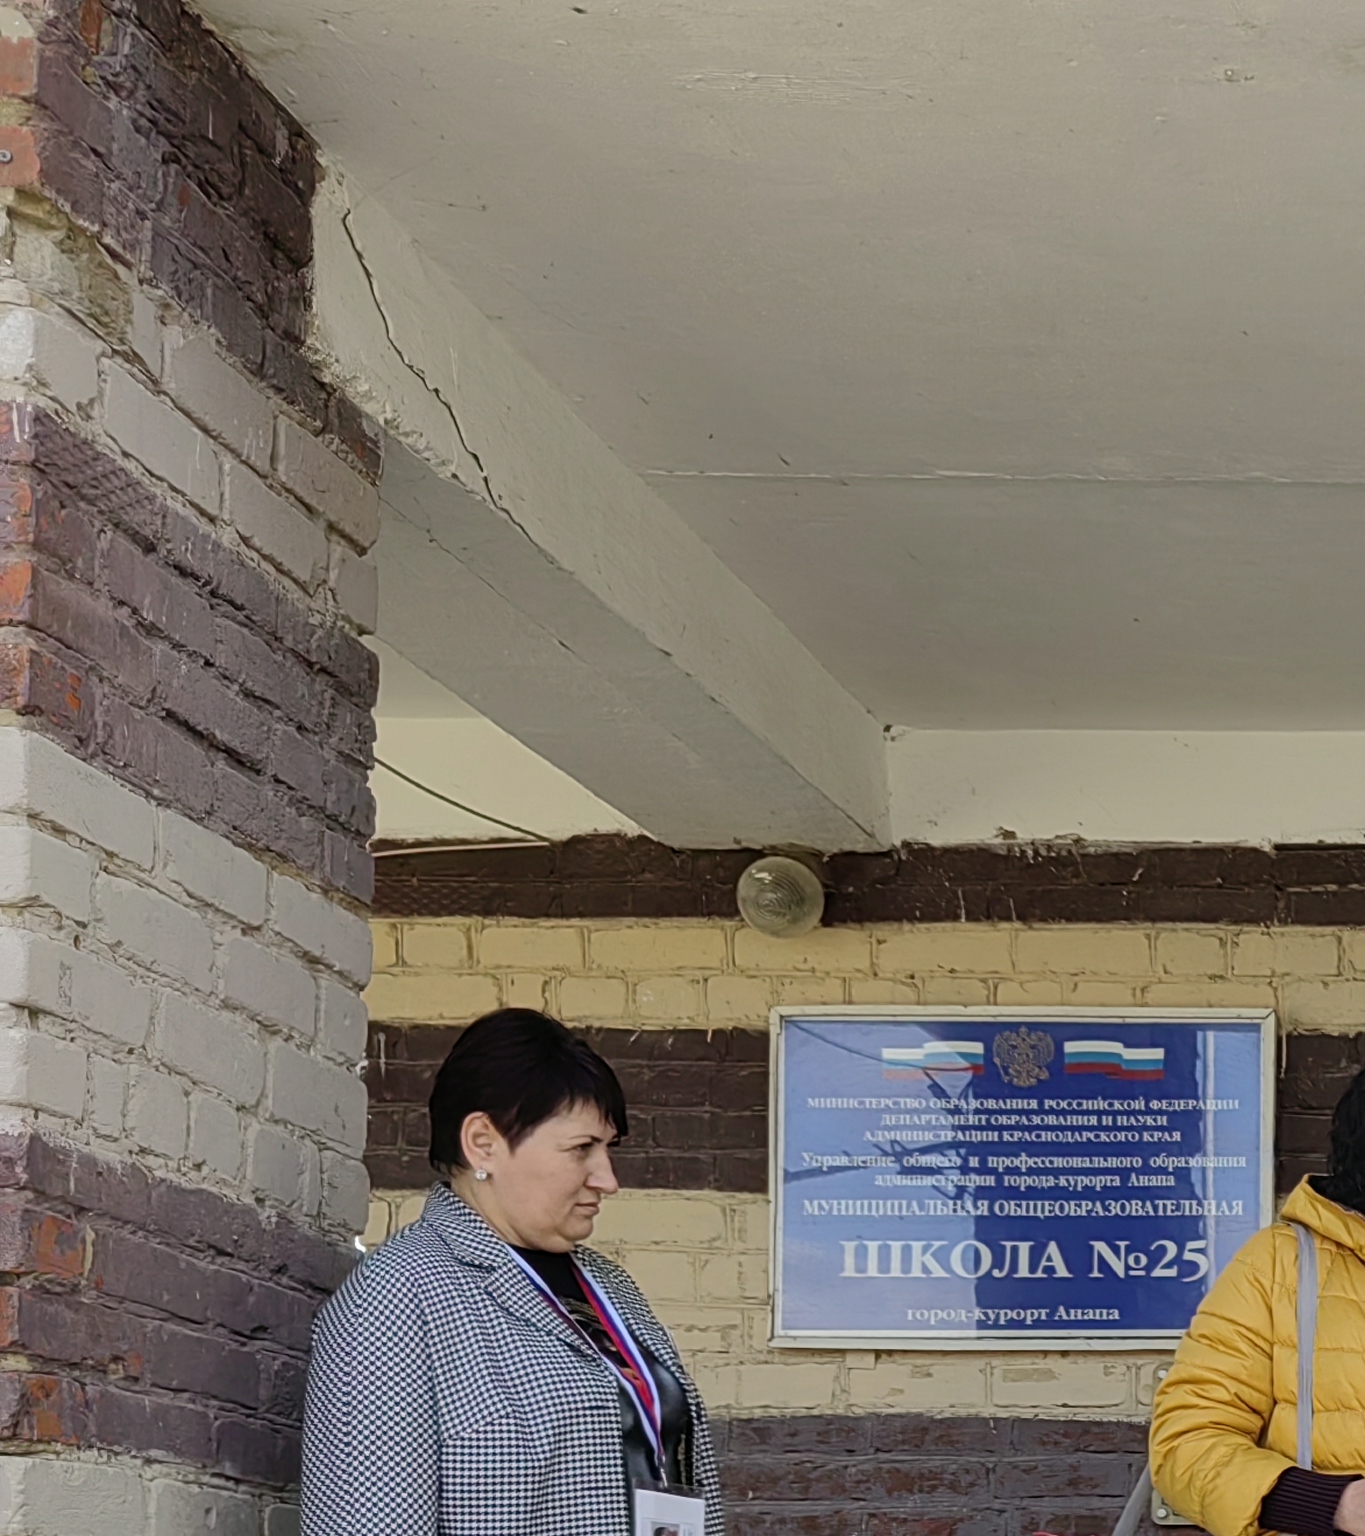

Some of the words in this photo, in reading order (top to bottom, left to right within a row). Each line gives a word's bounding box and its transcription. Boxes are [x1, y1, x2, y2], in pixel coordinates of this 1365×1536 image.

[807, 1097, 926, 1110] МИНИСТЕРСТВО
[929, 1098, 1039, 1110] ОБРАЗОВАНИЯ
[1043, 1096, 1145, 1111] РОССИЙСКОЙ
[1149, 1098, 1240, 1112] ФЕДЕРАЦИИ
[880, 1114, 988, 1127] ДЕПАРТАМЕНТ
[990, 1114, 1099, 1127] ОБРАЗОВАНИЯ
[1101, 1115, 1113, 1126] И
[1116, 1114, 1168, 1127] НАУКИ
[863, 1130, 999, 1143] АДМИНИСТРАЦИИ
[1002, 1130, 1140, 1144] КРАСНОДАРСКОГО
[1142, 1130, 1182, 1143] КРАЯ
[801, 1151, 896, 1171] Управление
[902, 1152, 962, 1169] общего
[968, 1156, 980, 1168] и
[987, 1152, 1143, 1173] профессионального
[1149, 1153, 1247, 1172] образования
[874, 1173, 996, 1190] администрации
[1003, 1174, 1121, 1192] города-курорта
[1127, 1173, 1175, 1187] Анапа
[803, 1199, 990, 1217] МУНИЦИПАЛЬНАЯ
[993, 1199, 1243, 1219] ОБЩЕОБРАЗОВАТЕЛЬНАЯ
[839, 1239, 1074, 1279] ШКОЛА
[1088, 1238, 1210, 1283] №25
[906, 1305, 1050, 1324] город-курорт
[1053, 1304, 1120, 1321] Анапа
